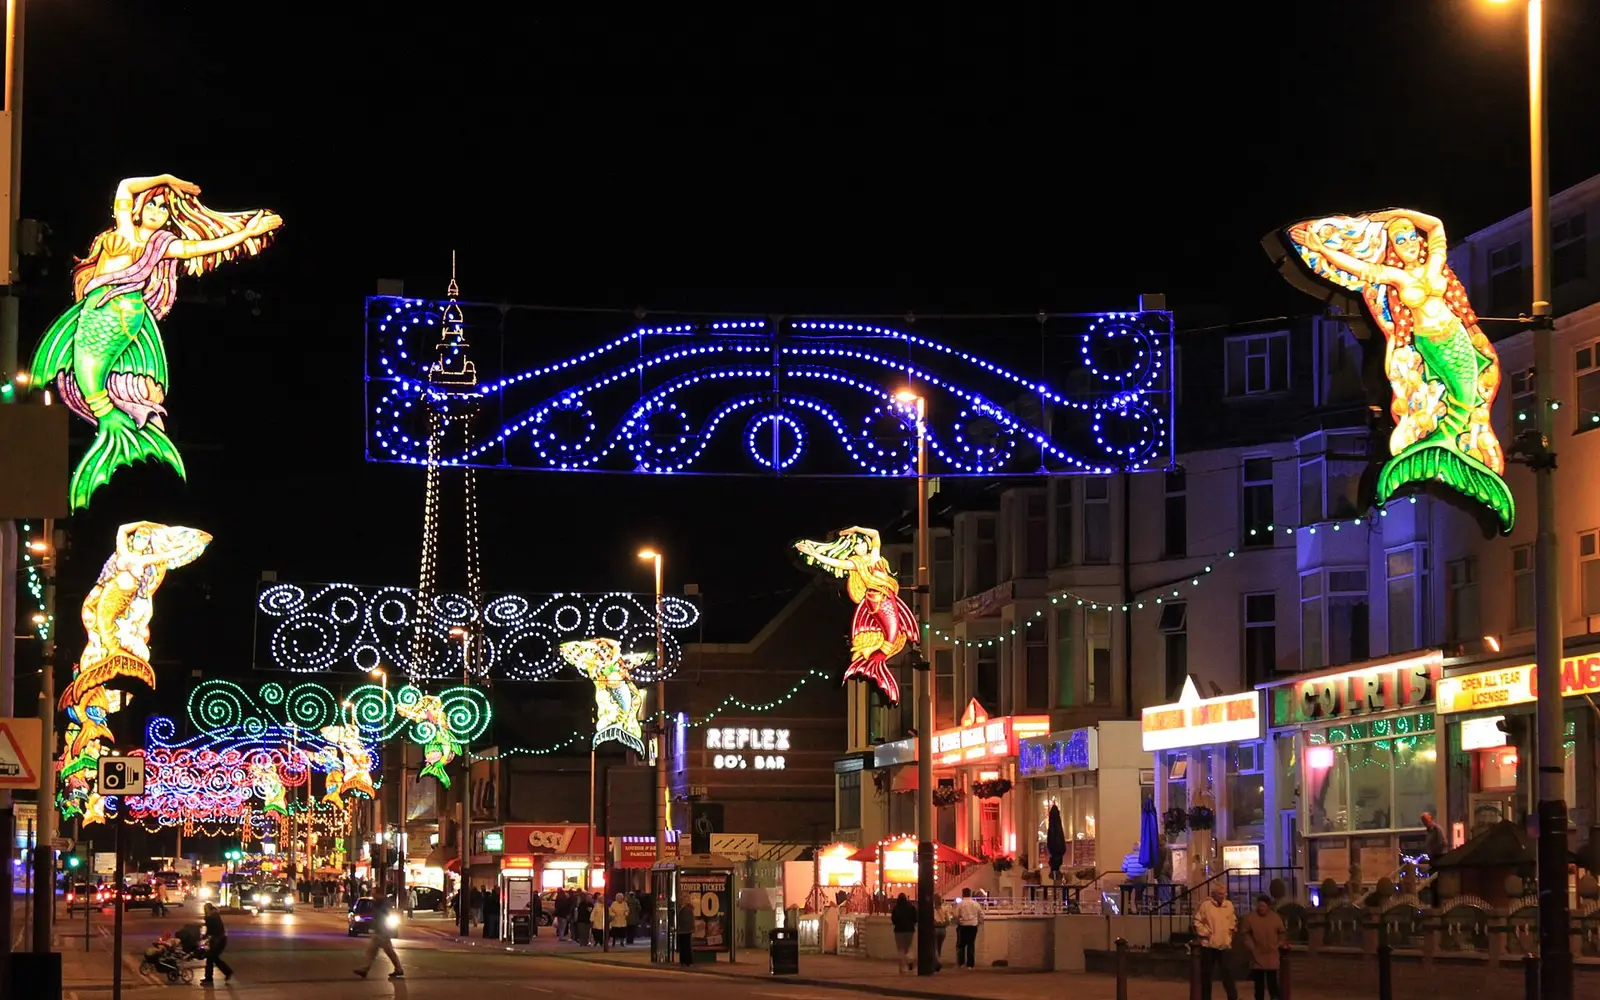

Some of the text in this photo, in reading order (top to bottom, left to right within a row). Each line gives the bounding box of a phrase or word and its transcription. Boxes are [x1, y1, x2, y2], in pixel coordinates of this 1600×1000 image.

[1461, 670, 1521, 691] OPEN ALL YEAR
[1530, 655, 1600, 698] AIG
[1301, 663, 1427, 718] COLRIS
[1471, 689, 1509, 706] LICENSED
[706, 727, 790, 751] REFLEX
[754, 755, 786, 770] BAR
[680, 883, 726, 892] TOWER TICKETS
